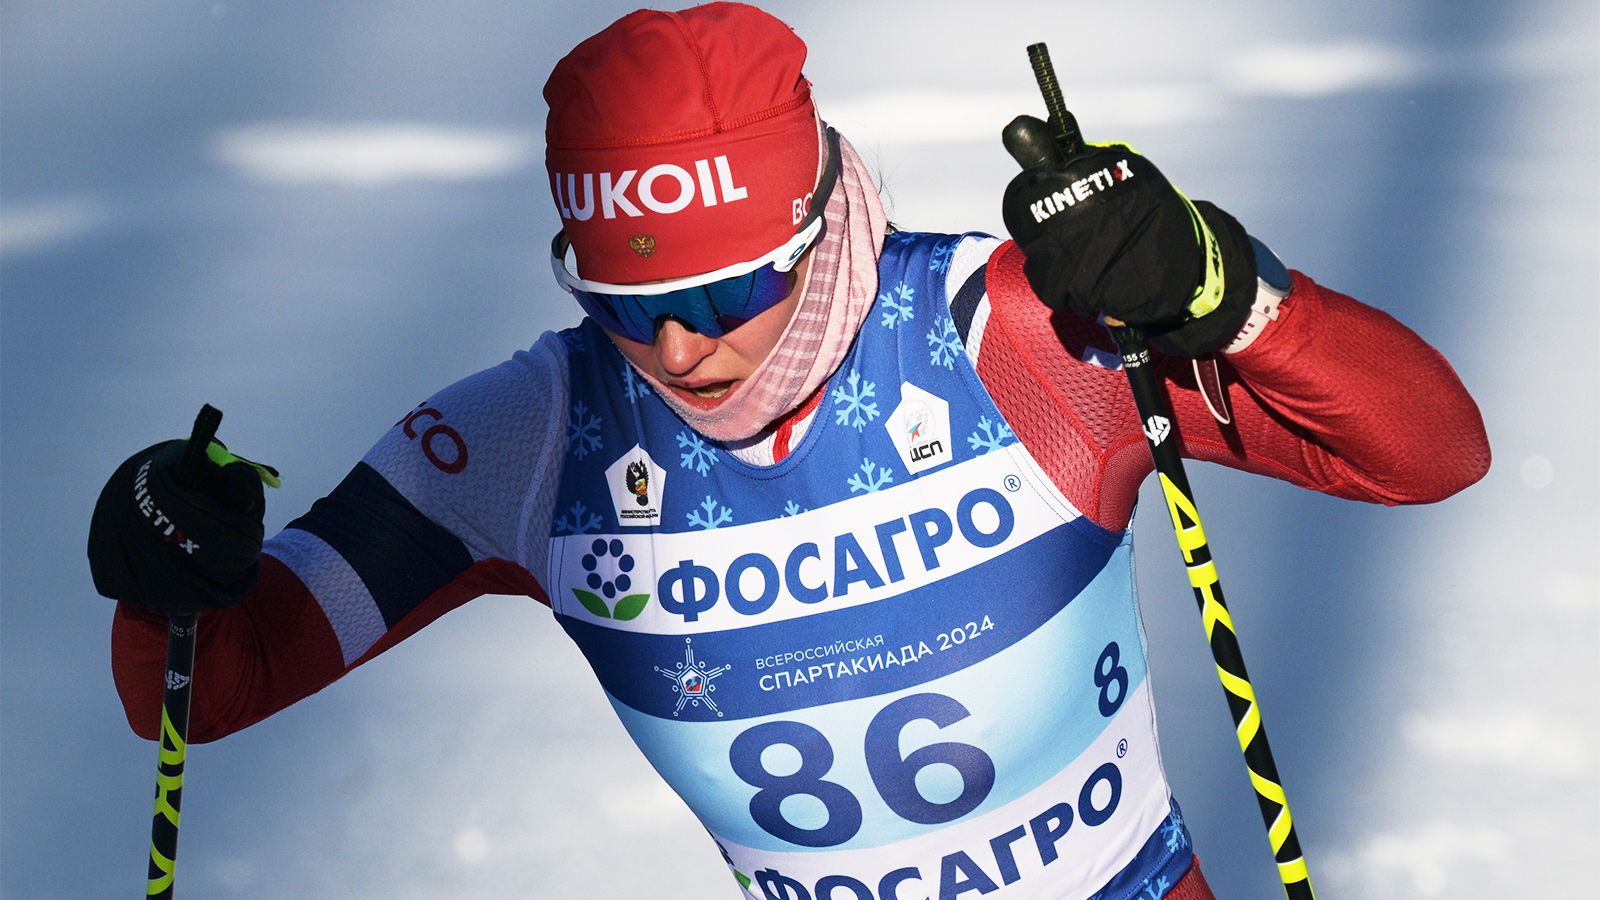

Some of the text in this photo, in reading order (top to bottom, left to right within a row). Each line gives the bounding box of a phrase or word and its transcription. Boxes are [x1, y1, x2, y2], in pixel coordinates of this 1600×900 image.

[555, 154, 748, 222] LUKOIL
[394, 402, 469, 475] CO
[909, 439, 944, 463] ЦСП
[656, 487, 1015, 623] ФОСАГРО
[755, 634, 885, 670] ВСЕРОССИЙСКАЯ
[758, 614, 995, 691] СПАРТАКИАДА 2024
[1093, 640, 1129, 718] 8
[728, 691, 996, 848] 86
